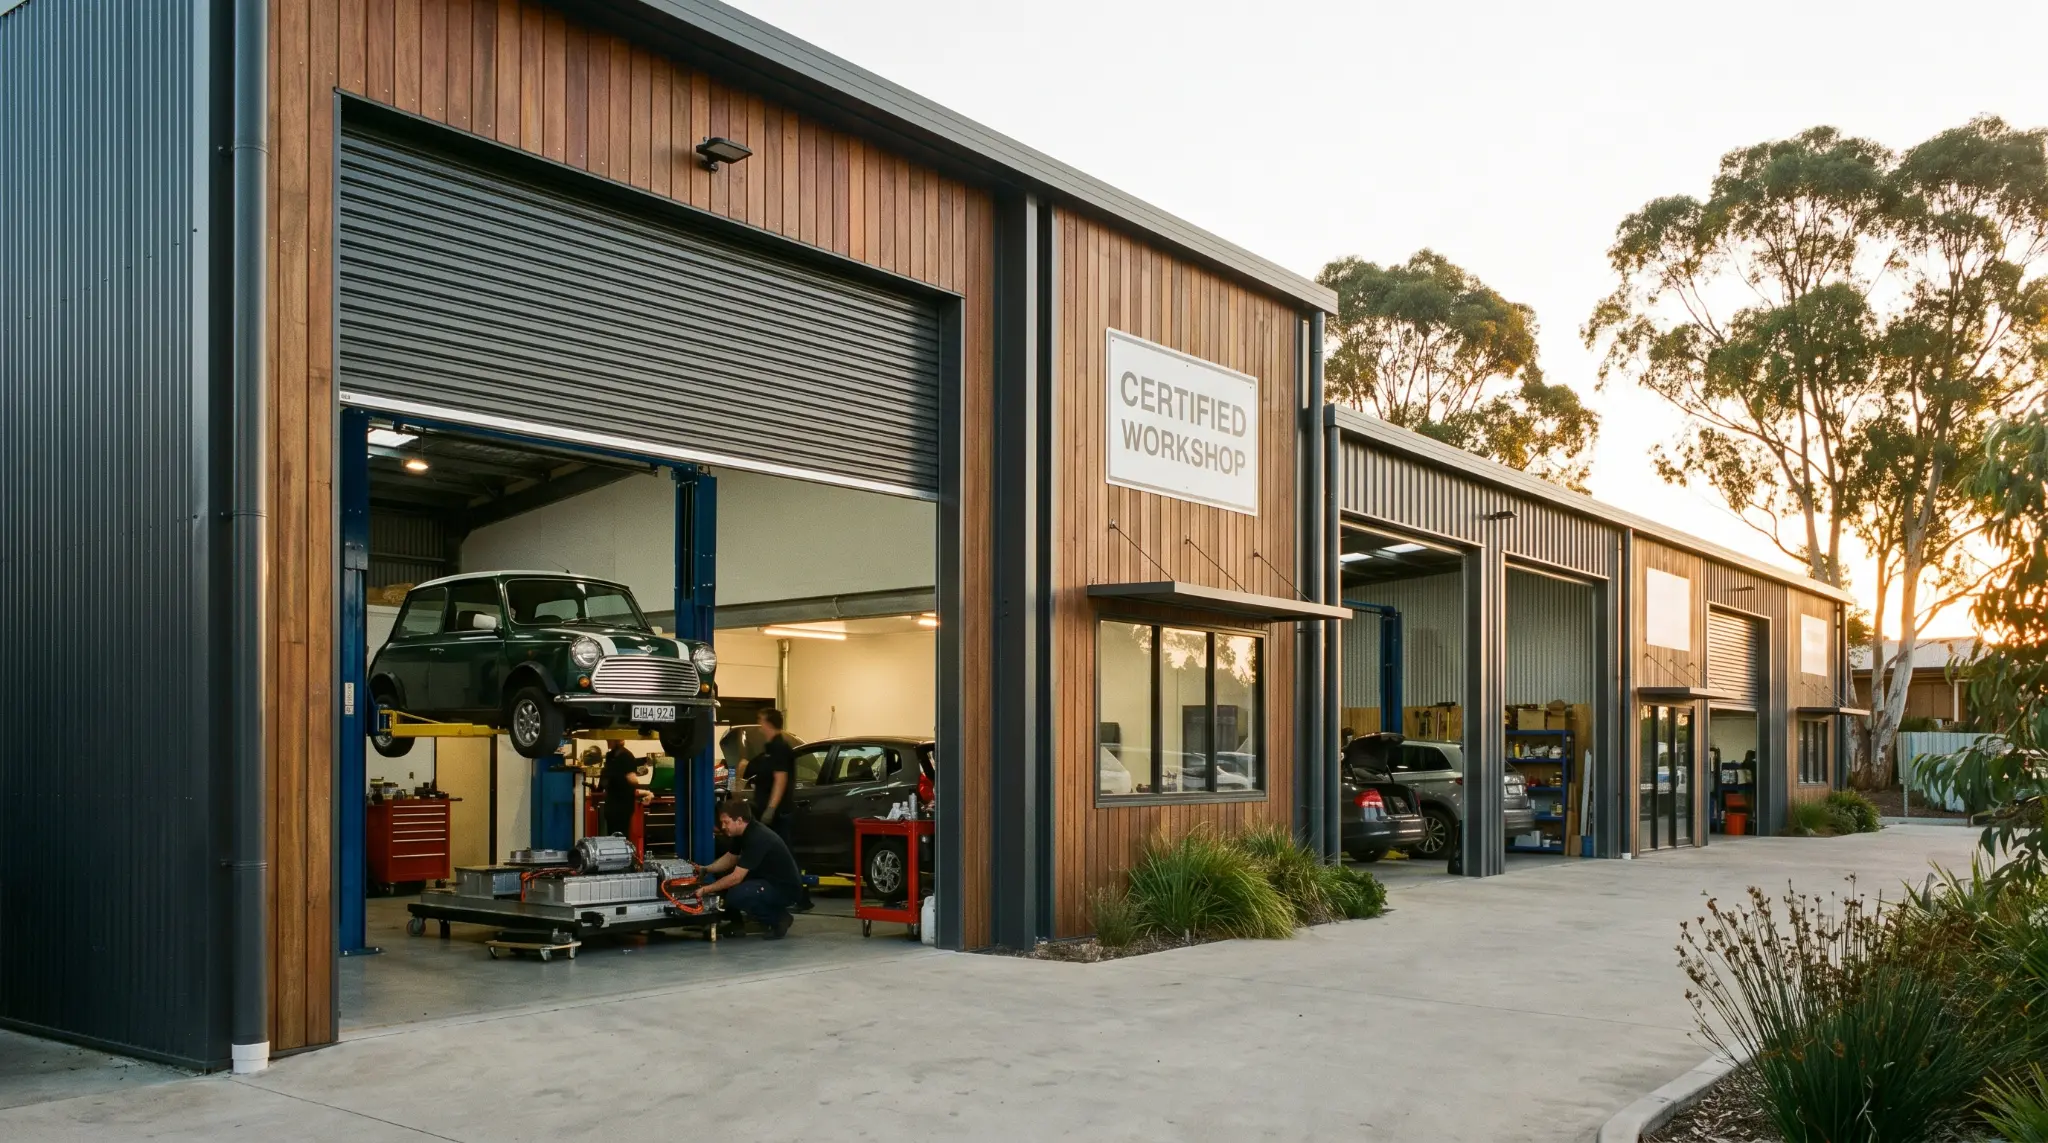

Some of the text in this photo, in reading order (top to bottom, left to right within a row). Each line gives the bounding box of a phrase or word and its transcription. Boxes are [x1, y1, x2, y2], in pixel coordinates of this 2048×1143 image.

[1120, 371, 1247, 438] CERTIFIED
[1121, 418, 1246, 477] WORKSHOP
[656, 707, 674, 719] 924
